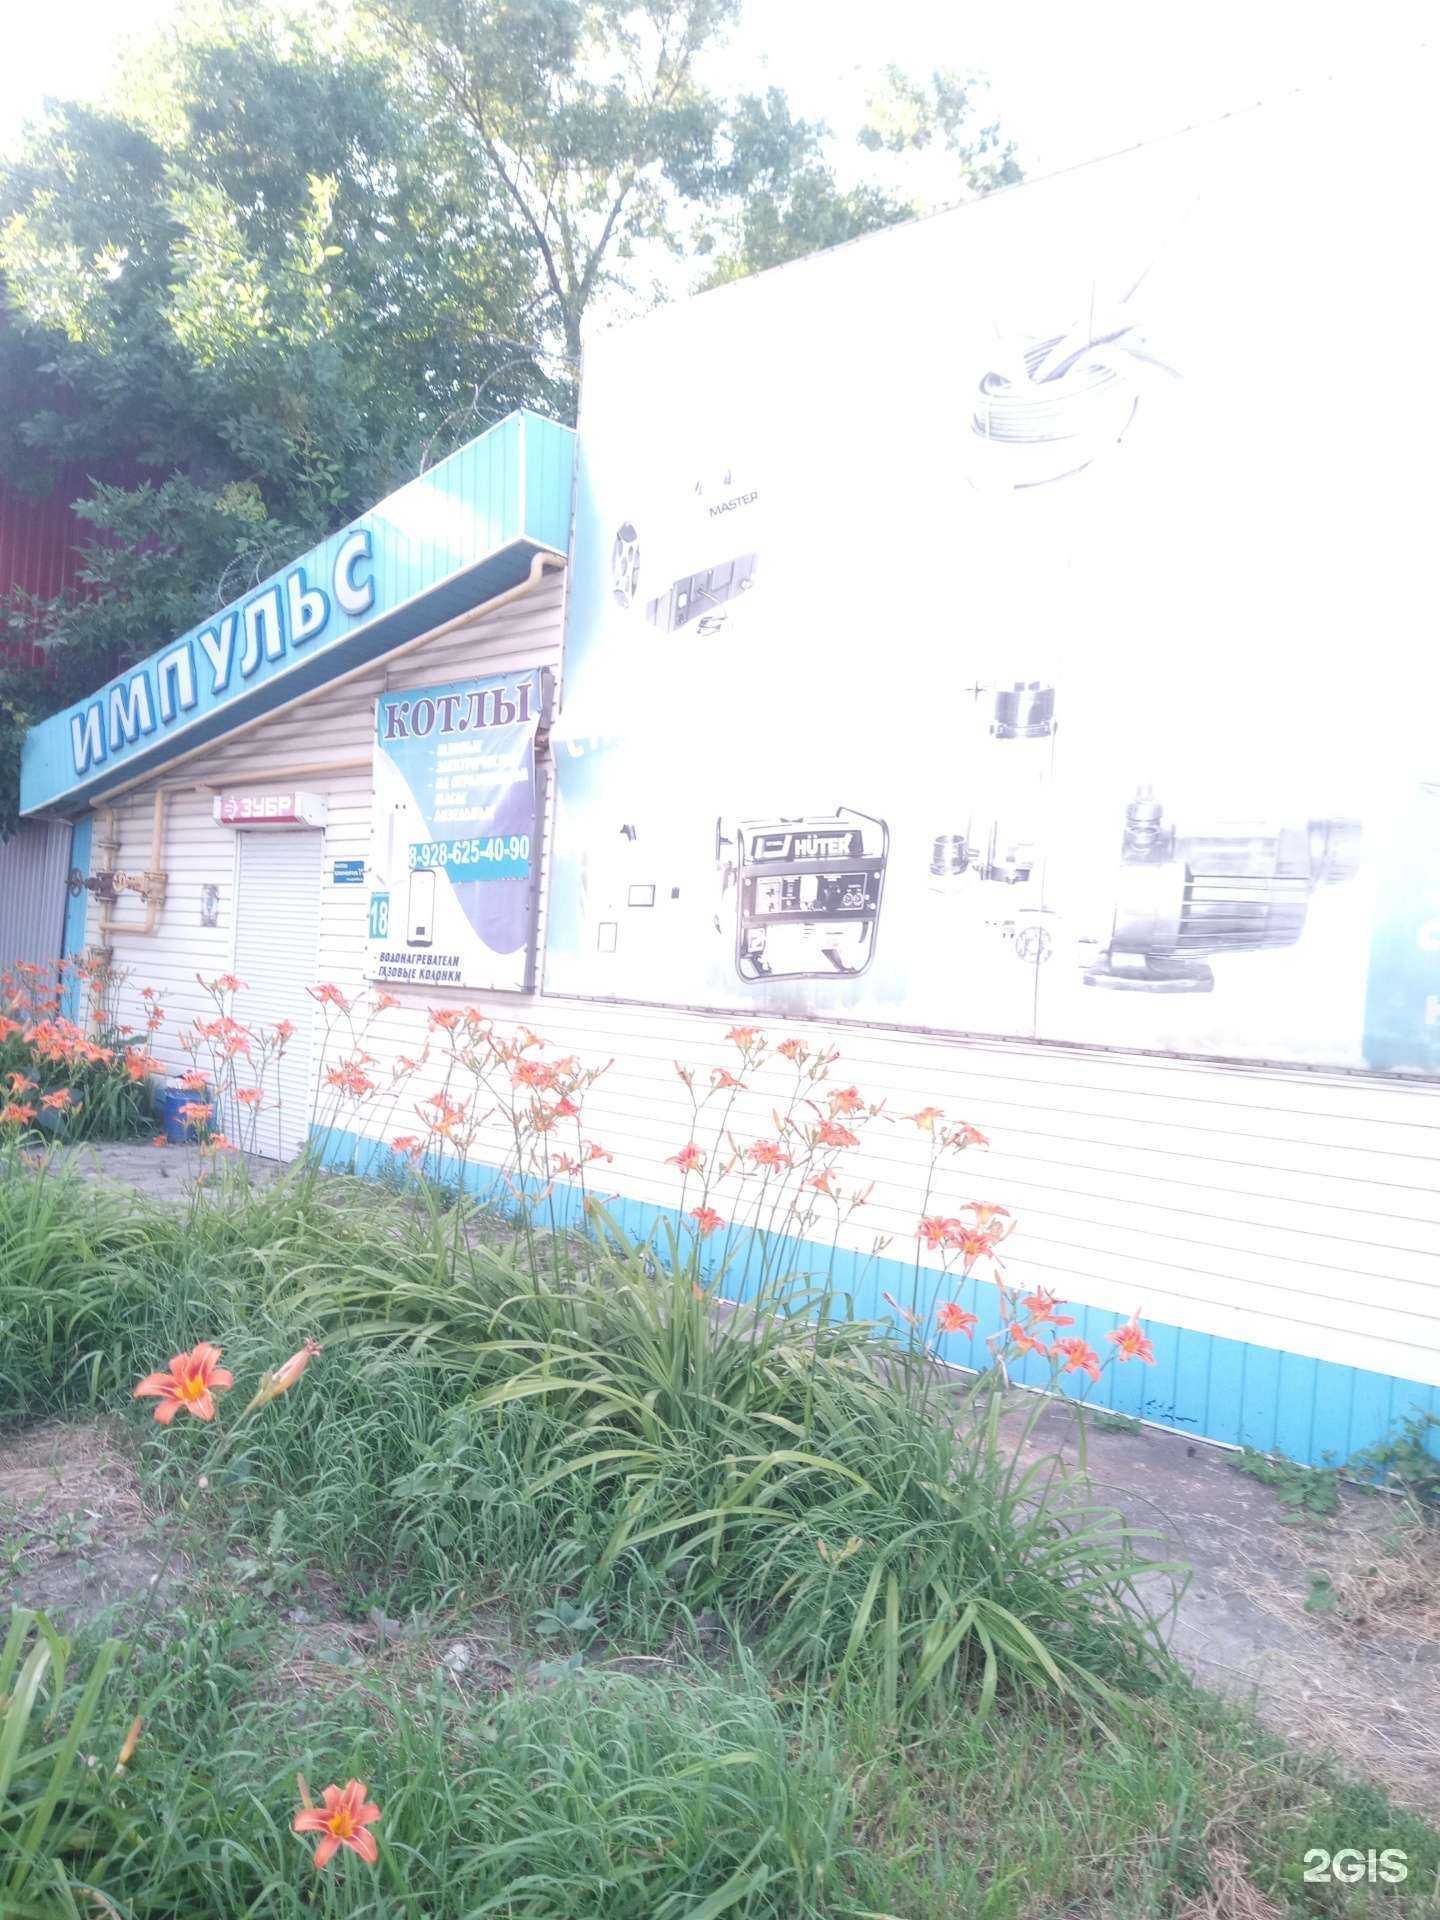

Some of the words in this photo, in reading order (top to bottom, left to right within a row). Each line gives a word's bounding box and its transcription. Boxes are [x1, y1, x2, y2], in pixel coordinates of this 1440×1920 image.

[709, 491, 758, 517] MASTER
[70, 530, 376, 775] ИМПУЛЬС
[384, 684, 532, 739] КОТЛЫ
[240, 796, 292, 818] ЗУБР
[409, 835, 529, 867] 8-928-625-40-90
[370, 901, 389, 936] 18
[379, 952, 460, 966] ВОДОНАГРЕВАТЕЛИ
[379, 966, 417, 979] ГАЗОВЫЕ
[419, 969, 462, 982] КОЛОНКИ
